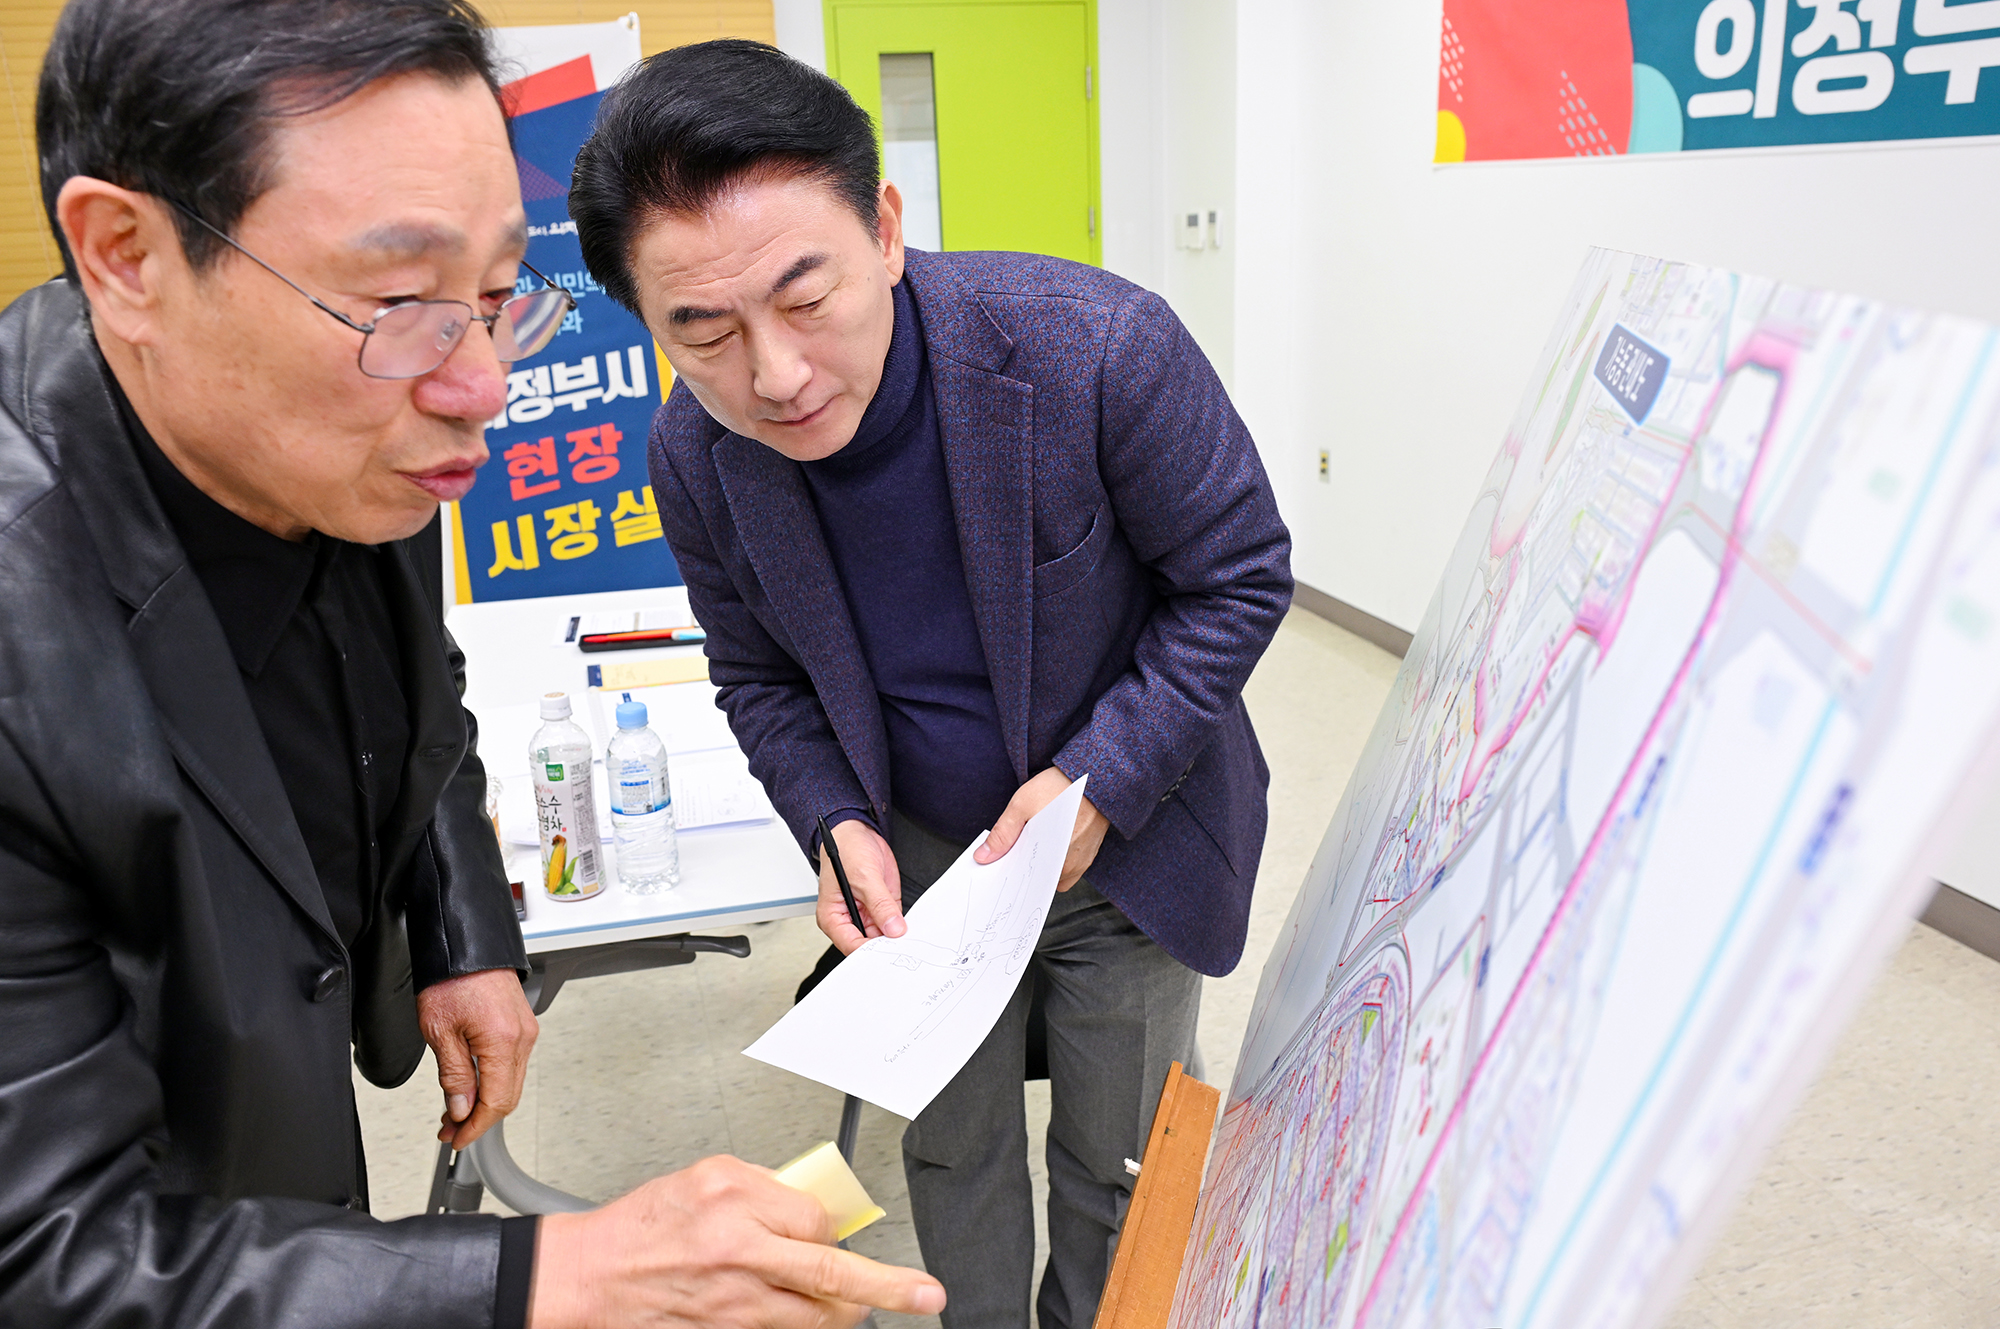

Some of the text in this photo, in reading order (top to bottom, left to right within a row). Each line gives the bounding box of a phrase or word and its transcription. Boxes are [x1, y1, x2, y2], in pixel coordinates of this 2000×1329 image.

[1687, 0, 2000, 118] 의정부
[556, 308, 583, 336] 화
[503, 422, 623, 501] 현장
[488, 485, 664, 578] 시장실
[535, 795, 562, 815] 수수
